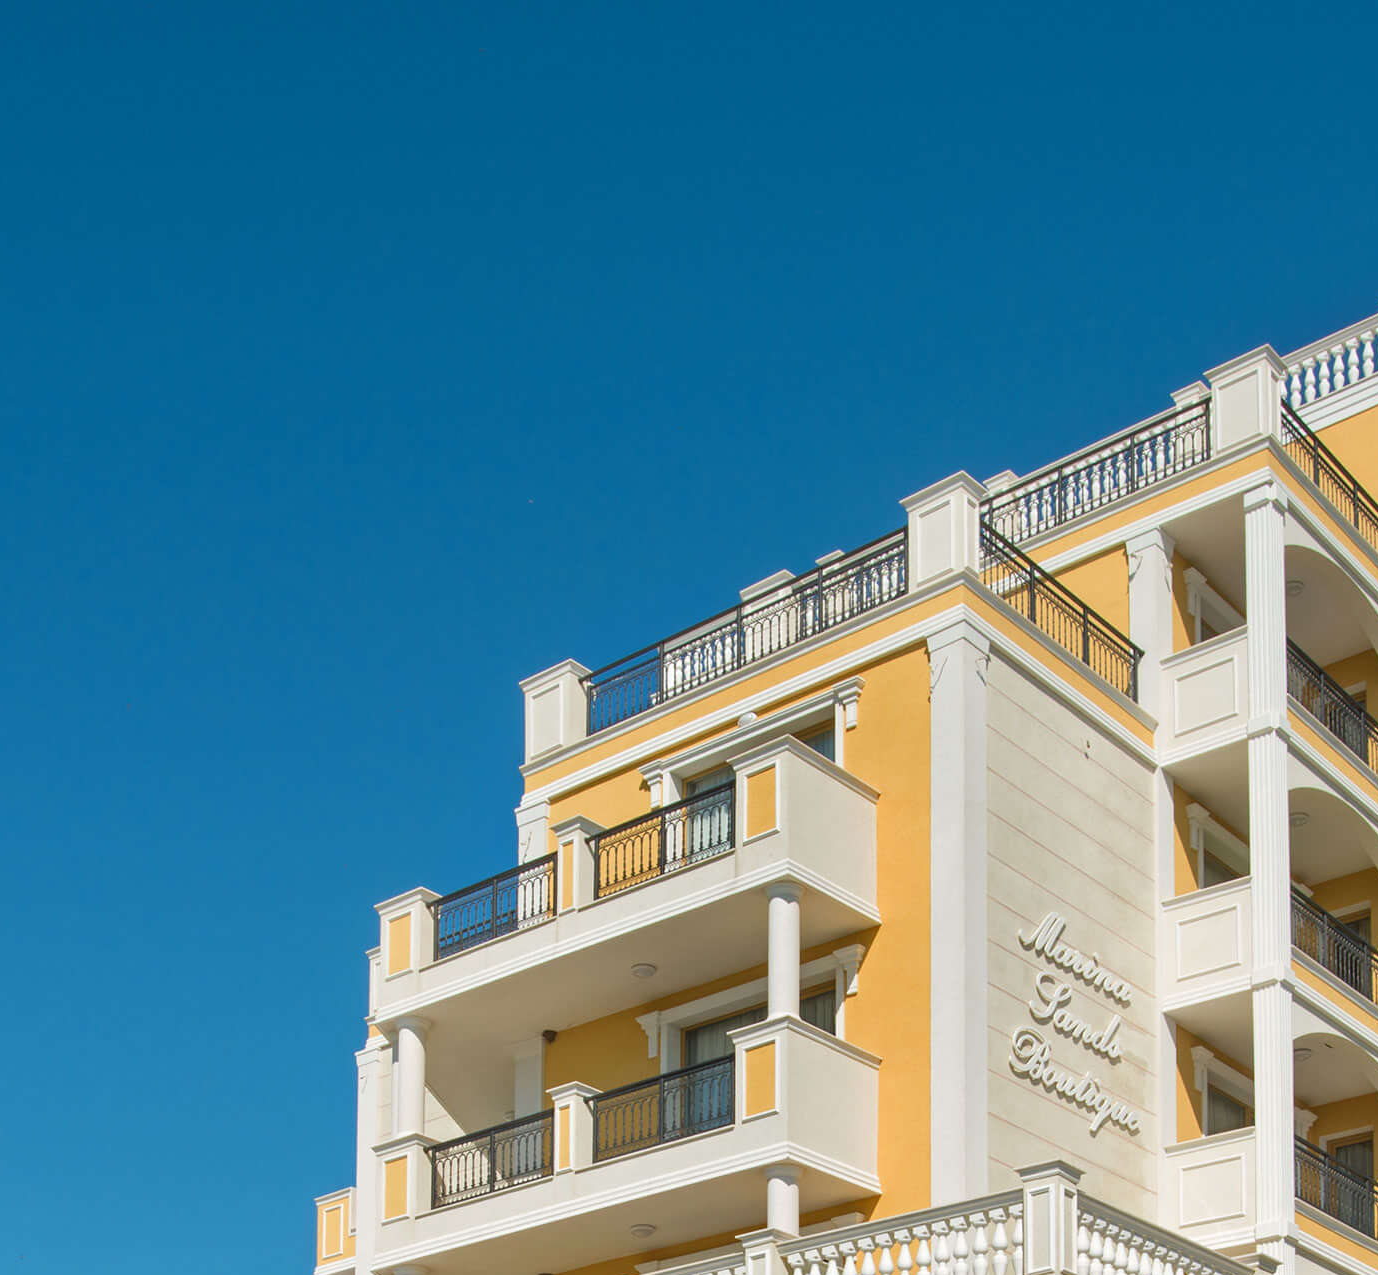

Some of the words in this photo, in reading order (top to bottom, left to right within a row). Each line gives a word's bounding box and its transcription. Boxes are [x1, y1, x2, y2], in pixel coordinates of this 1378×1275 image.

[1017, 910, 1132, 1002] Marina
[1028, 969, 1124, 1059] Sands
[1008, 1024, 1143, 1132] Boutique
